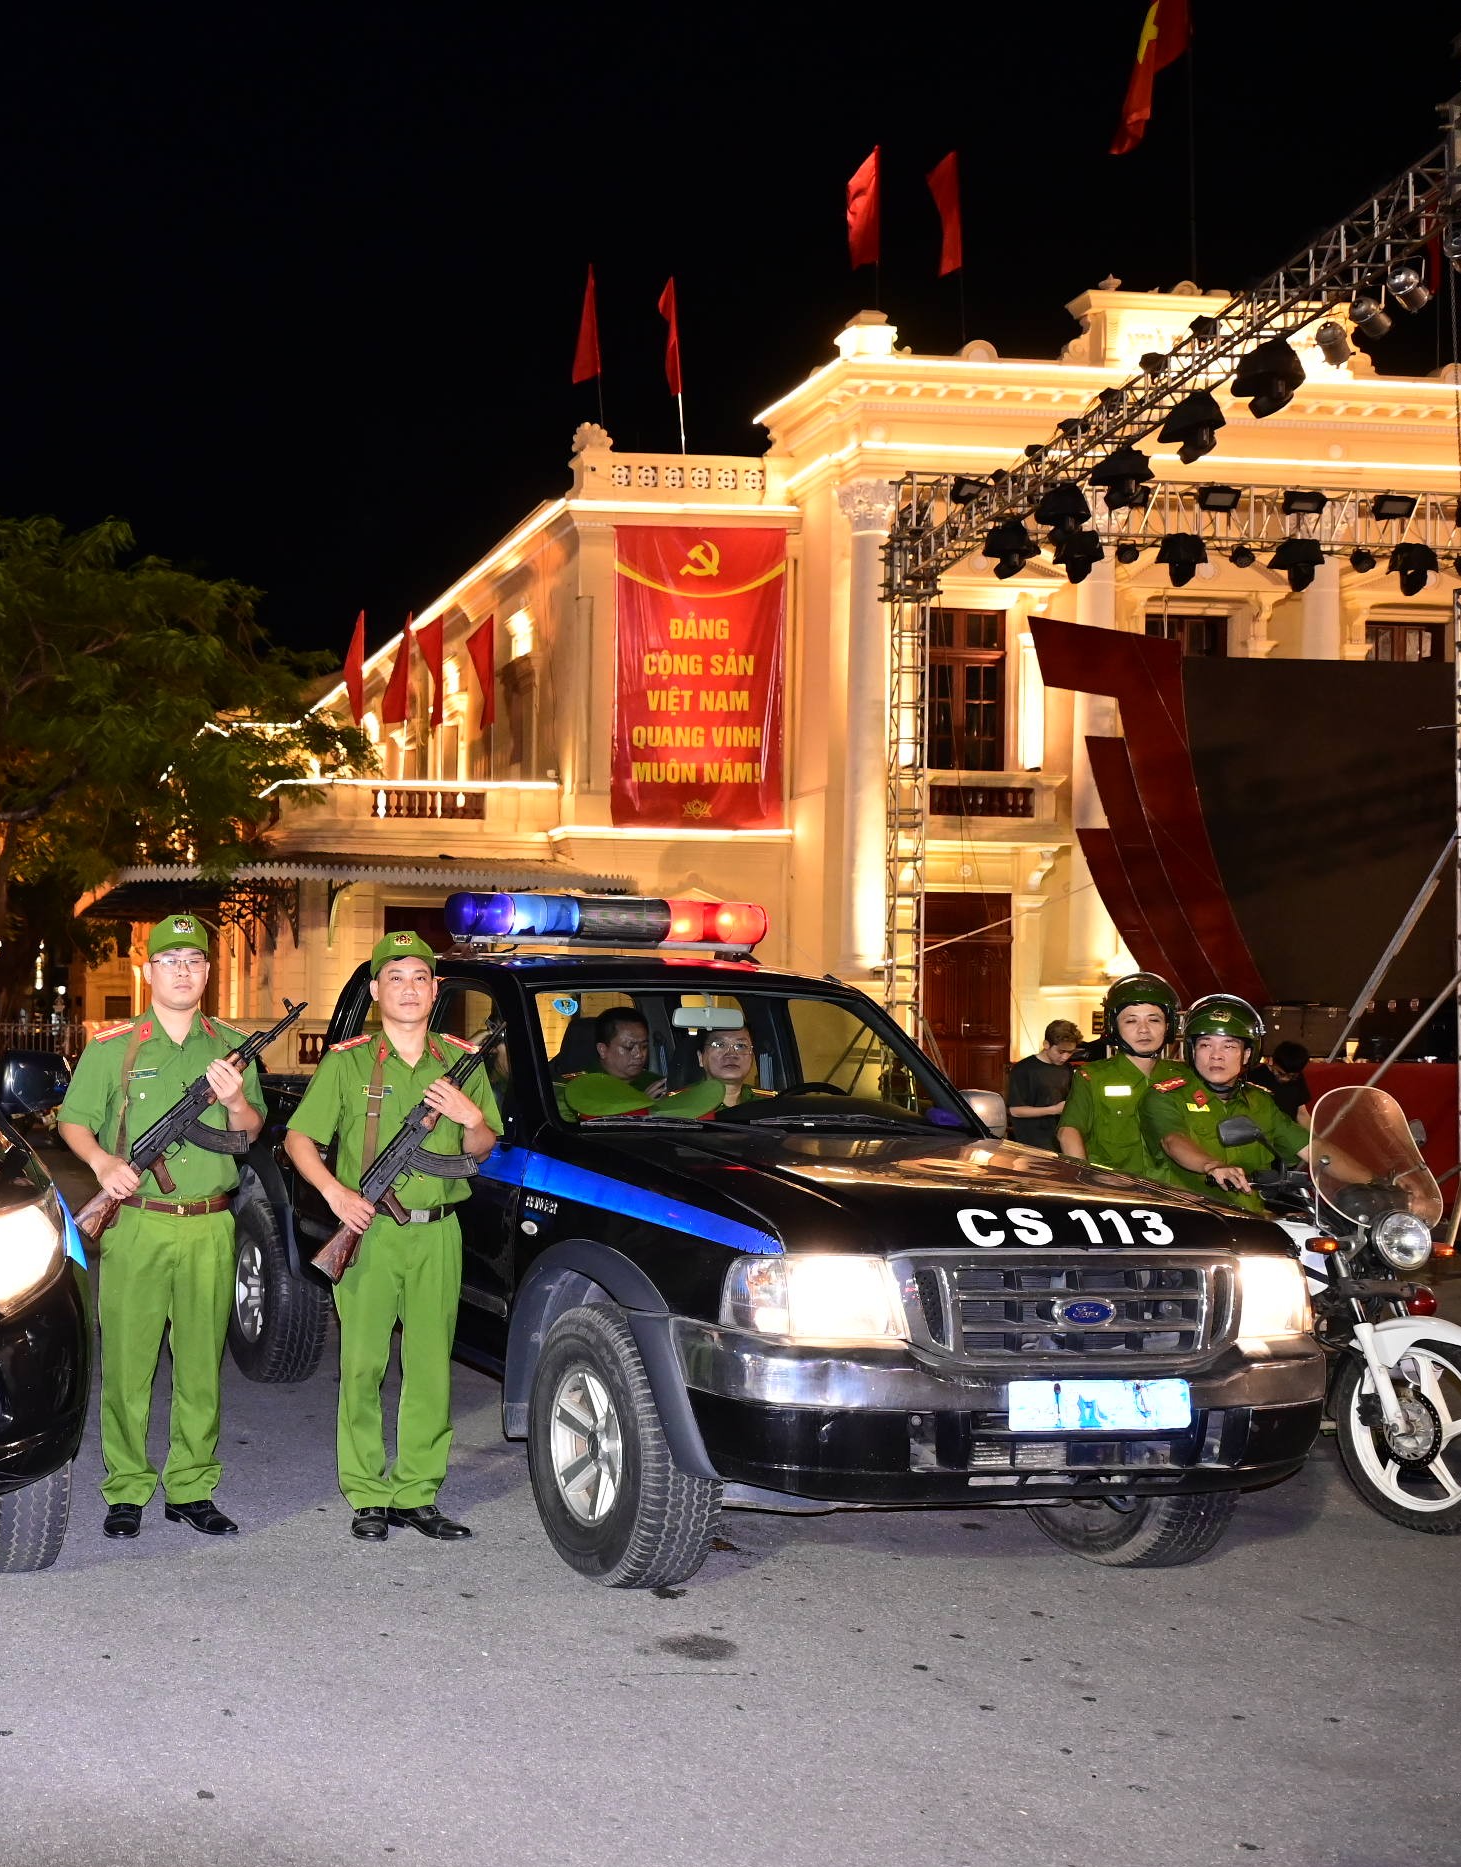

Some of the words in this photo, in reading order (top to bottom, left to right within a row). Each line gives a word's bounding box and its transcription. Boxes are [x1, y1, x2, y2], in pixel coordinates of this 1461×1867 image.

[668, 611, 730, 640] ĐẢNG
[643, 649, 703, 680] CỘNG
[709, 647, 755, 676] SẢN
[646, 685, 693, 716] VIỆT
[699, 690, 749, 712] NAM
[632, 725, 705, 749] QUANG
[711, 726, 761, 748] VINH
[631, 757, 696, 784] MUÔN
[703, 757, 761, 784] NĂM!
[956, 1207, 1054, 1247] CS
[1067, 1209, 1175, 1246] 113
